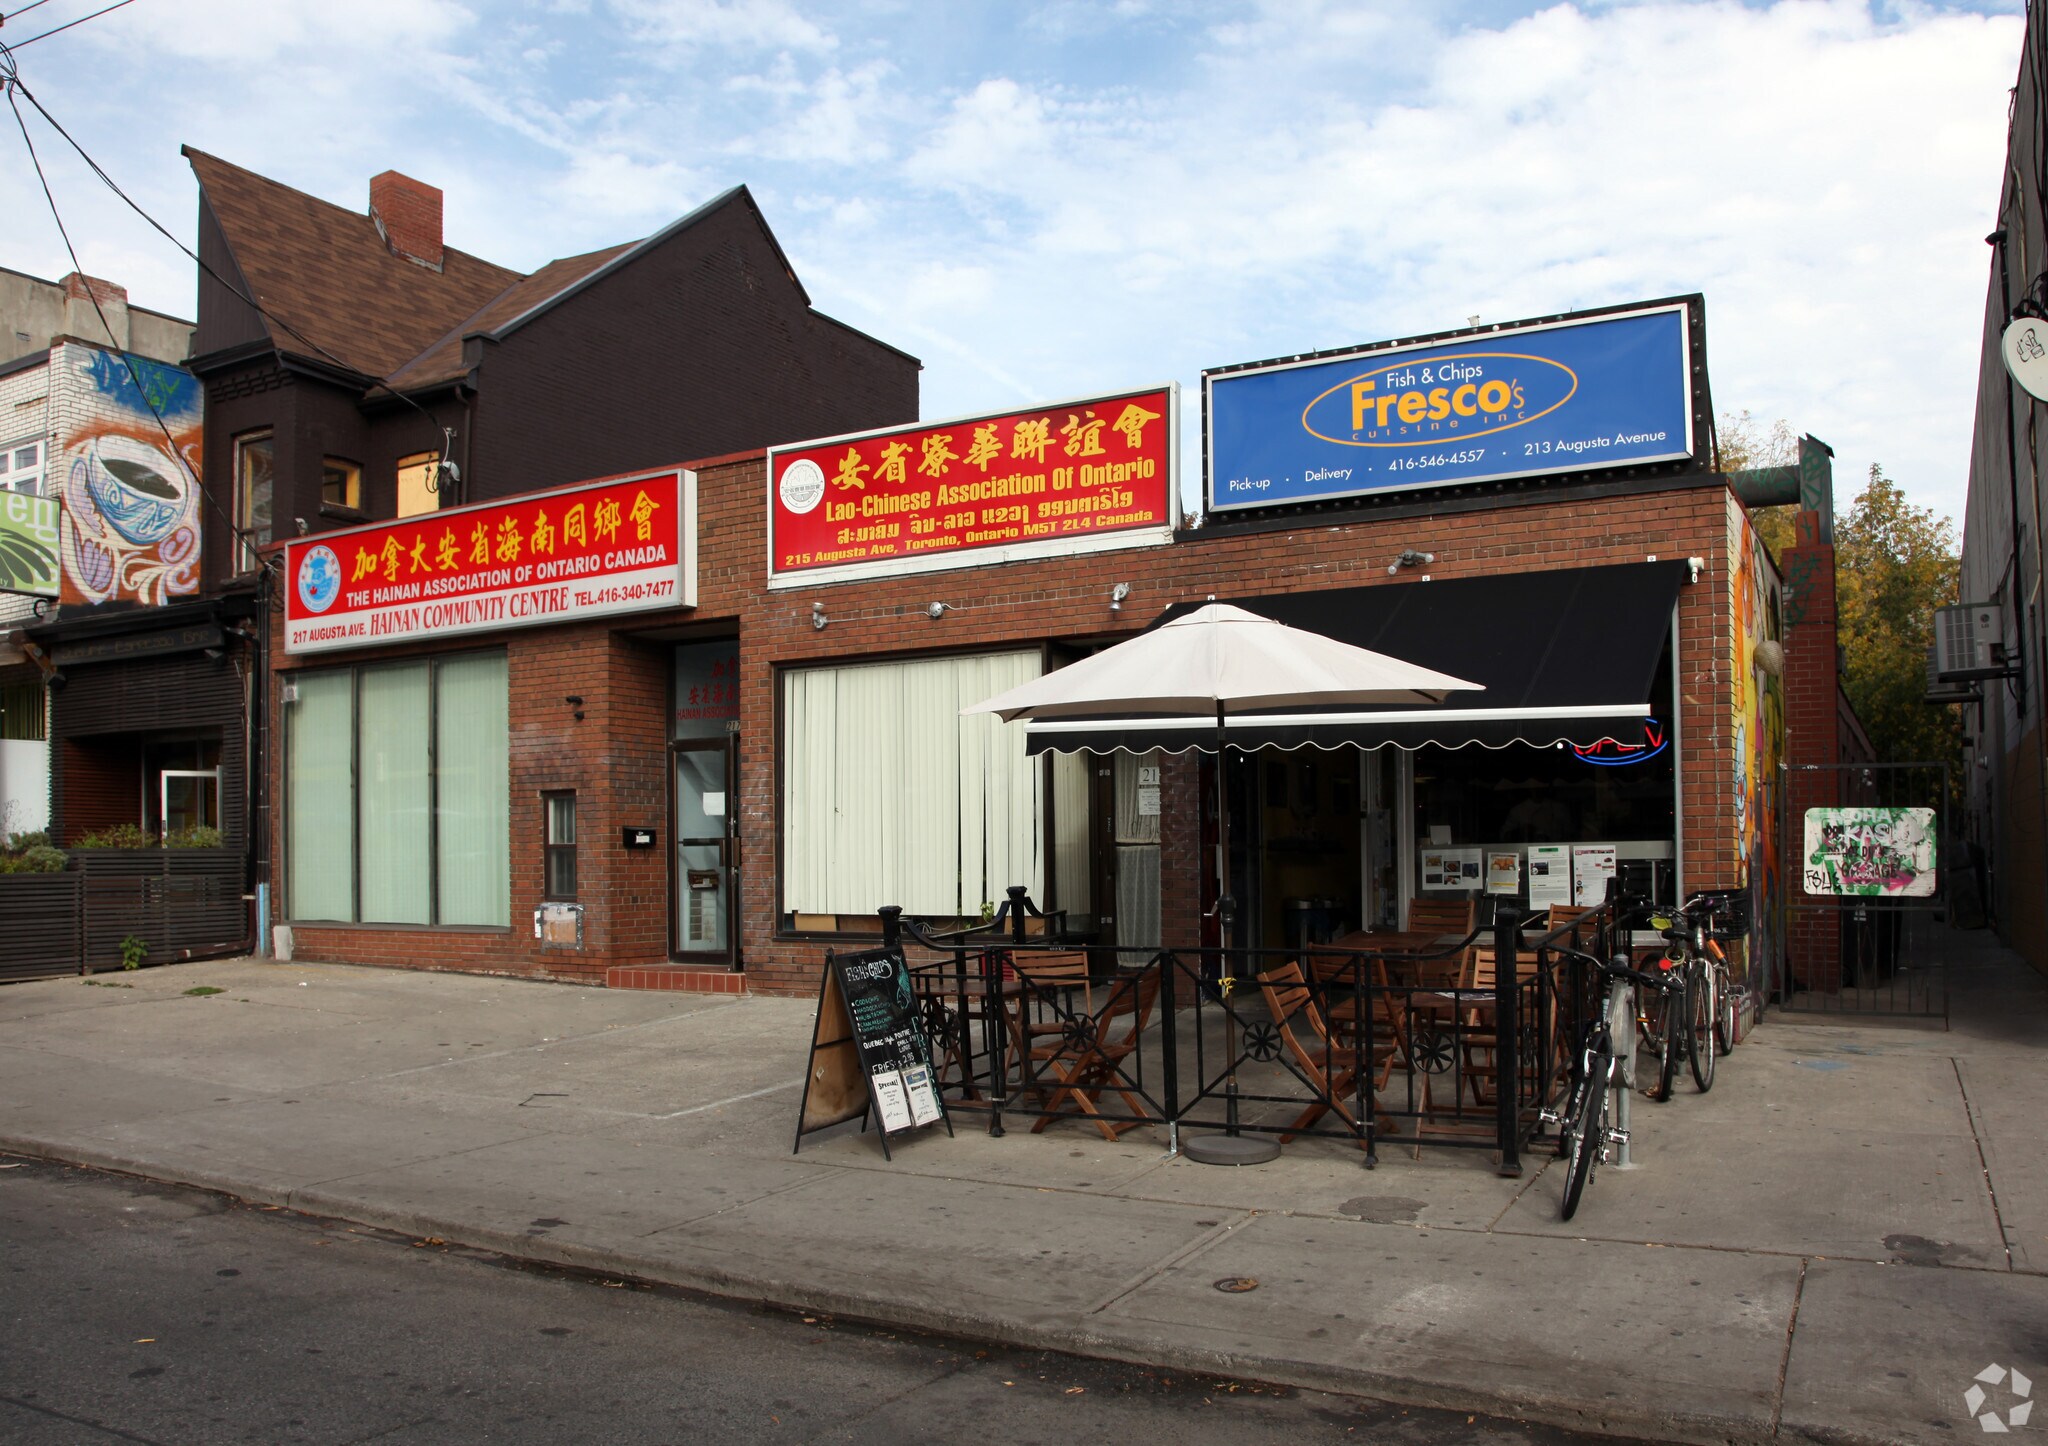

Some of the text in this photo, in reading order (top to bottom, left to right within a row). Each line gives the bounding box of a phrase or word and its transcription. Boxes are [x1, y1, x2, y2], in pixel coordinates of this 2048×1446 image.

[1386, 362, 1483, 388] Fish & Chips
[1351, 378, 1525, 431] Fresco's
[1352, 410, 1525, 441] cuisine inc
[826, 490, 931, 523] Lao-Chinese
[936, 472, 1046, 507] Association
[1052, 466, 1074, 491] Of
[1080, 456, 1155, 487] Ontario
[1229, 475, 1271, 492] Pick-up
[1304, 466, 1353, 483] Delivery
[1524, 442, 1551, 456] 213
[1555, 436, 1610, 454] Augusta
[1614, 431, 1667, 446] Avenue
[351, 489, 661, 583] 加拿大安省海南同鄉會
[785, 510, 1153, 566] 215 Augusta Ave, Toronto, Ontario M5T 2L4 Canada
[346, 589, 370, 608] THE
[373, 581, 420, 604] HAINAN
[423, 565, 511, 597] ASSOCIATION
[514, 564, 533, 583] OF
[536, 554, 600, 577] ONTARIO
[604, 543, 667, 569] CANADA
[293, 630, 307, 644] 217
[309, 624, 347, 641] AUGUSTA
[348, 622, 366, 637] AVE.
[370, 607, 420, 636] HAINAN
[423, 596, 507, 629] COMMUNITY
[510, 586, 570, 618] CENTRE
[676, 707, 701, 721] HAINAN
